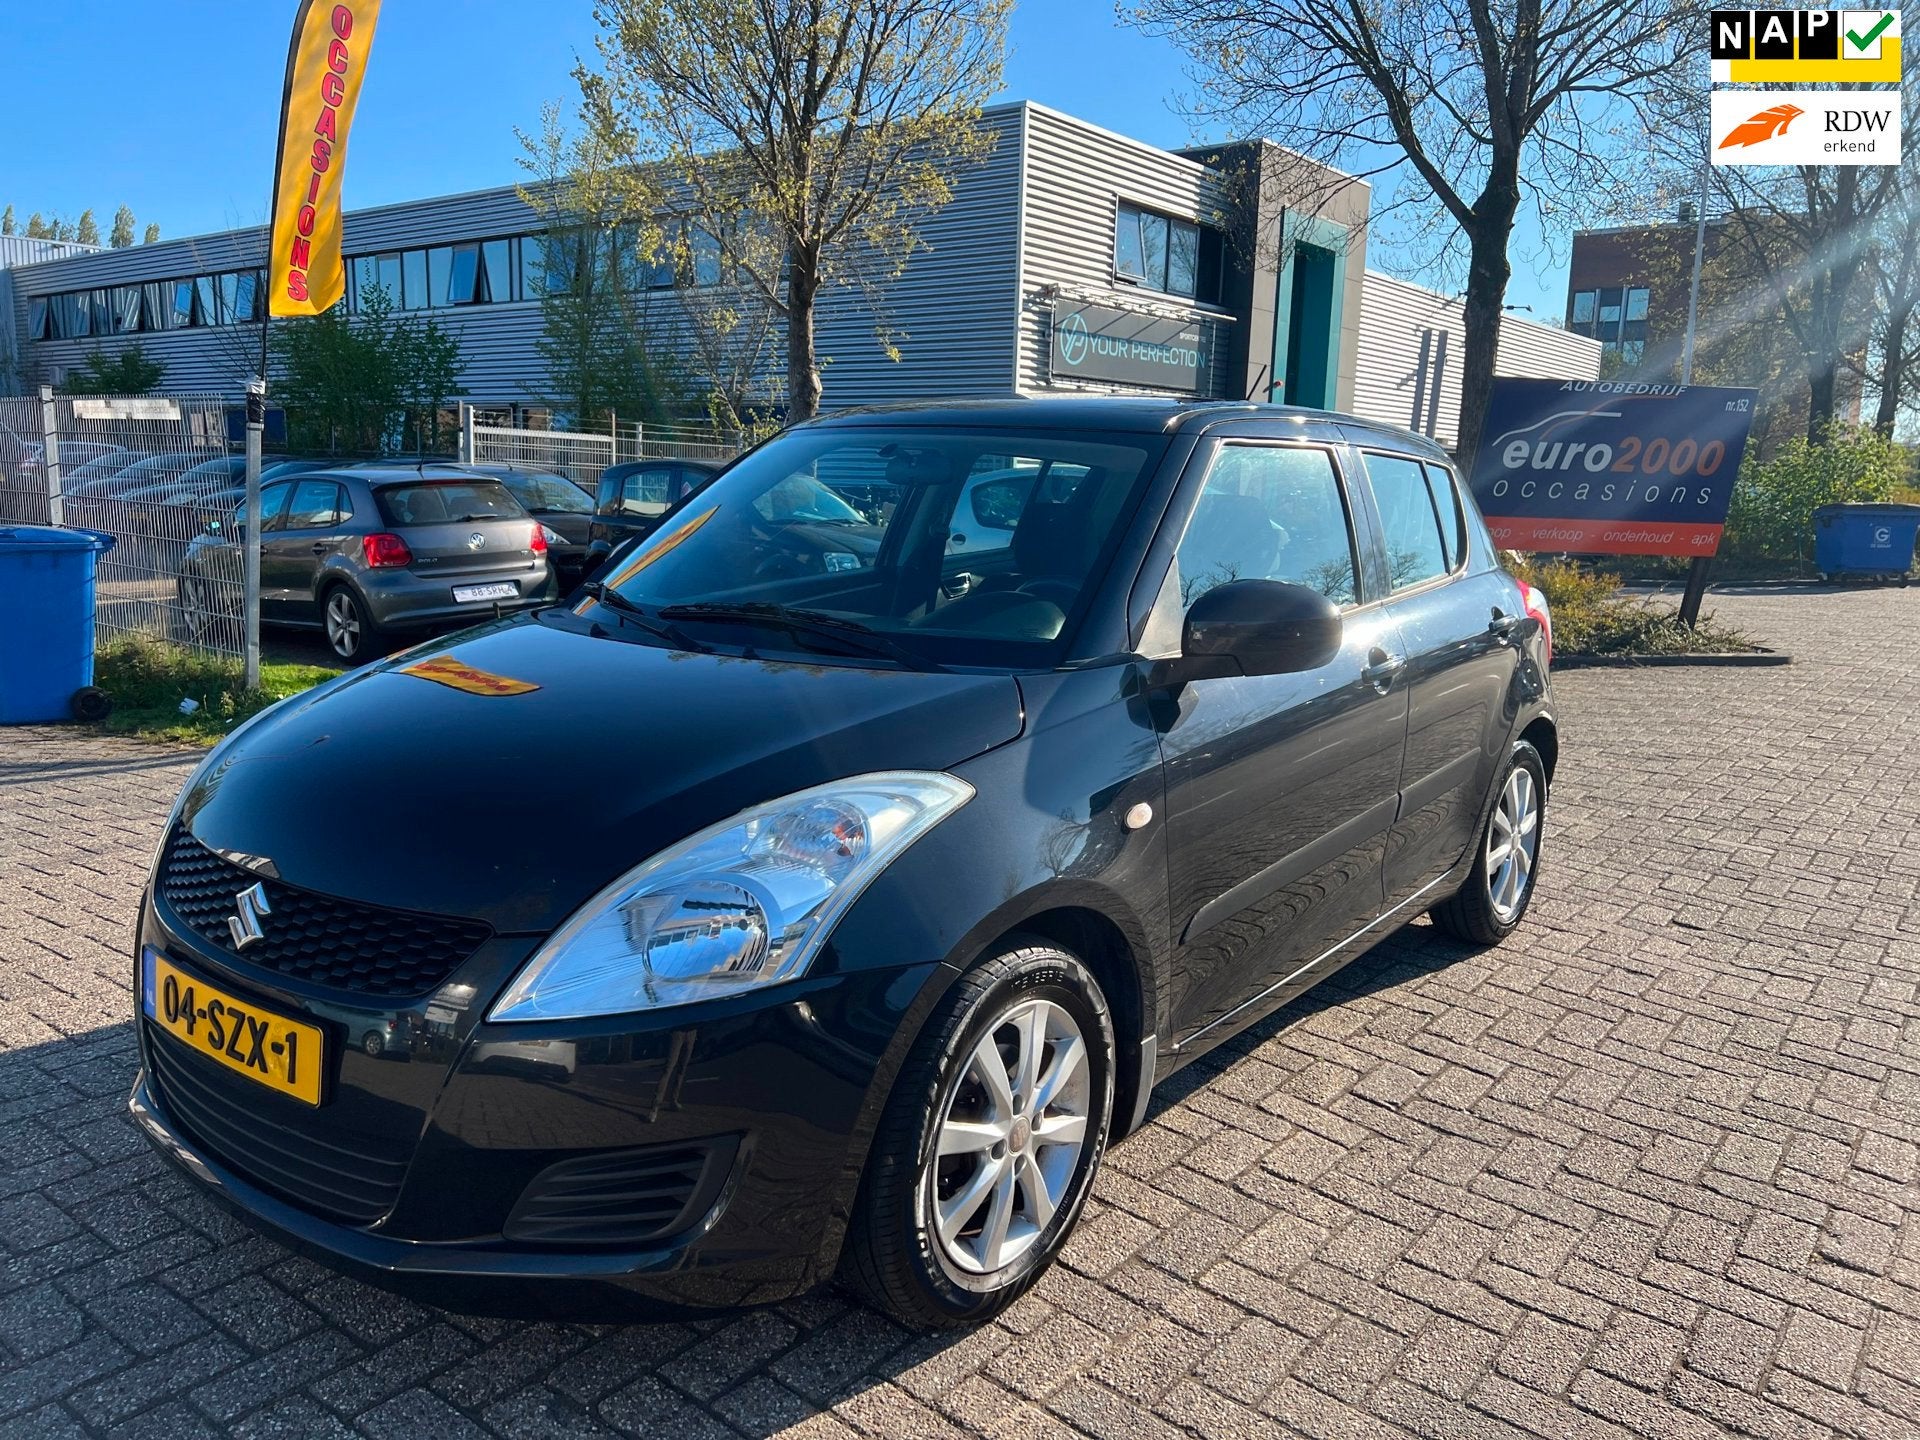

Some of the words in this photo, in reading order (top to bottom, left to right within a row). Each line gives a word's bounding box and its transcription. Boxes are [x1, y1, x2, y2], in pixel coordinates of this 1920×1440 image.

[287, 4, 353, 302] OCCASIONS
[1090, 334, 1129, 359] YOUR
[1131, 339, 1207, 369] PERFECTION
[1560, 380, 1689, 397] AUTOBEDRIJF
[1725, 399, 1750, 413] nr.152
[1502, 436, 1725, 477] euro2000
[1493, 480, 1712, 505] occasions
[1532, 526, 1584, 543] verkoop
[1603, 530, 1674, 544] onderhoud
[1691, 531, 1716, 545] apk
[163, 974, 298, 1085] 04-SZX-1
